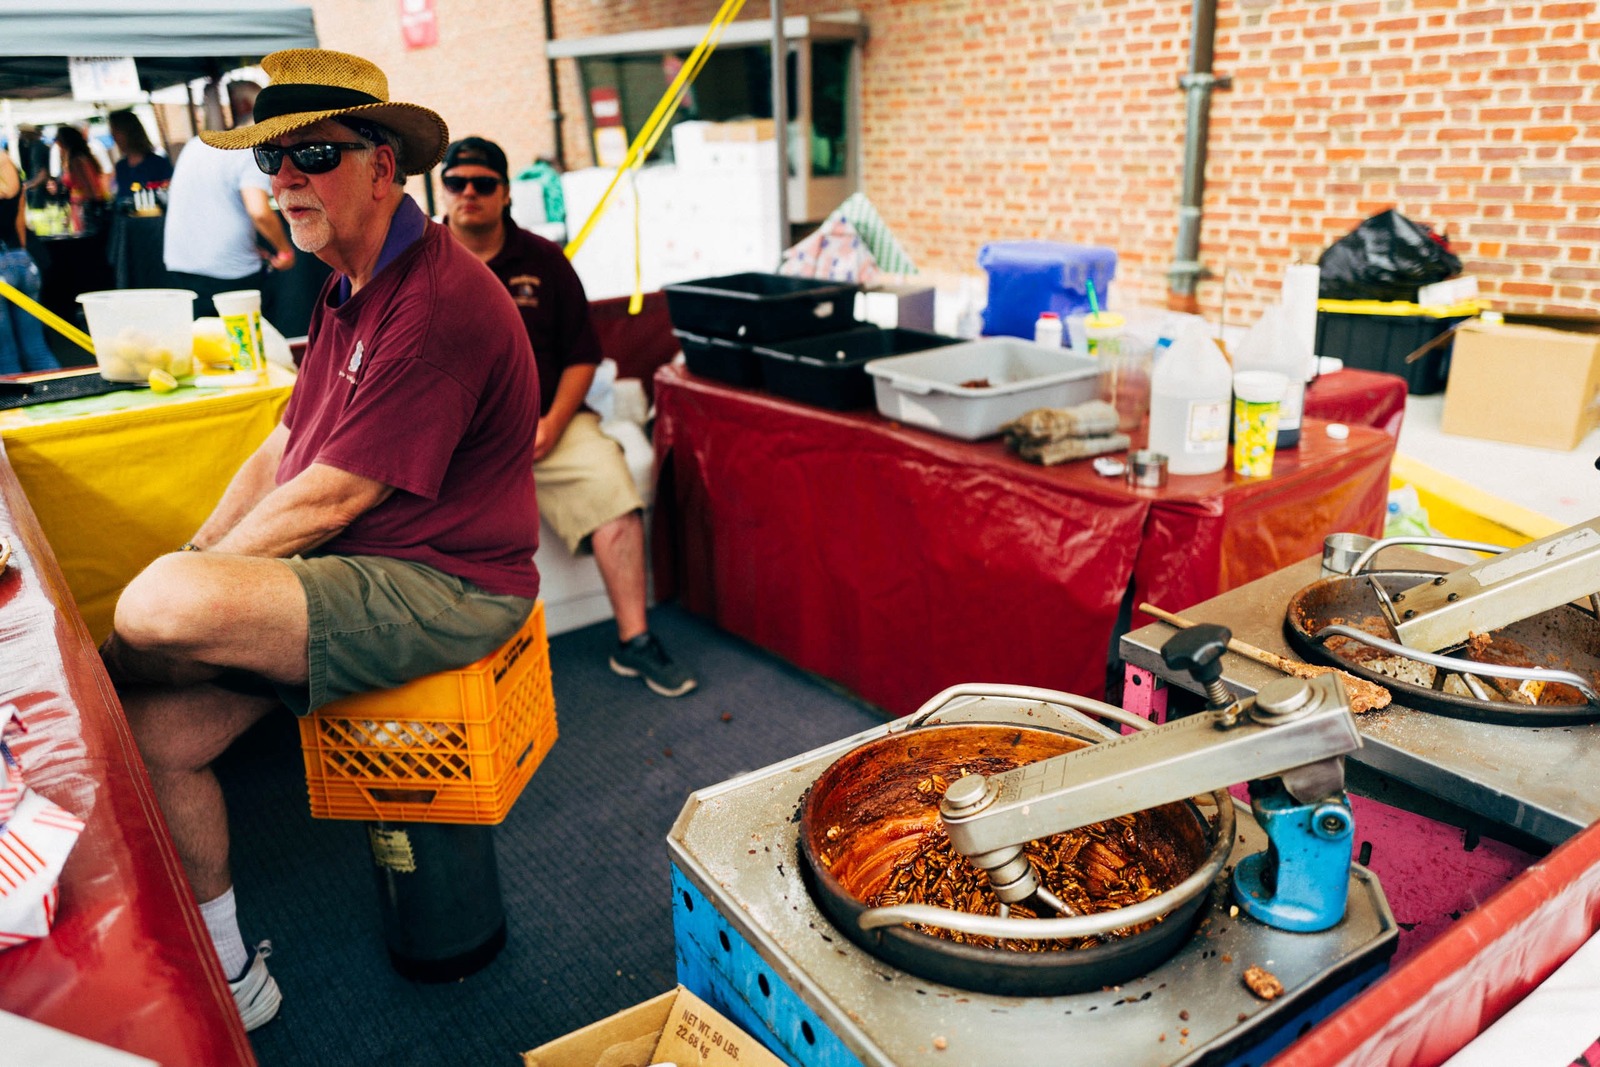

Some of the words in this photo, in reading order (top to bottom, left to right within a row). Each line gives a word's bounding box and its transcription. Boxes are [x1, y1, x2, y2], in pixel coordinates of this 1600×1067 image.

[675, 1024, 699, 1049] 22.68
[699, 1040, 711, 1059] kg
[681, 1009, 699, 1027] NET
[698, 1019, 711, 1039] WT.
[711, 1031, 723, 1047] 50
[723, 1039, 740, 1061] LBS.
